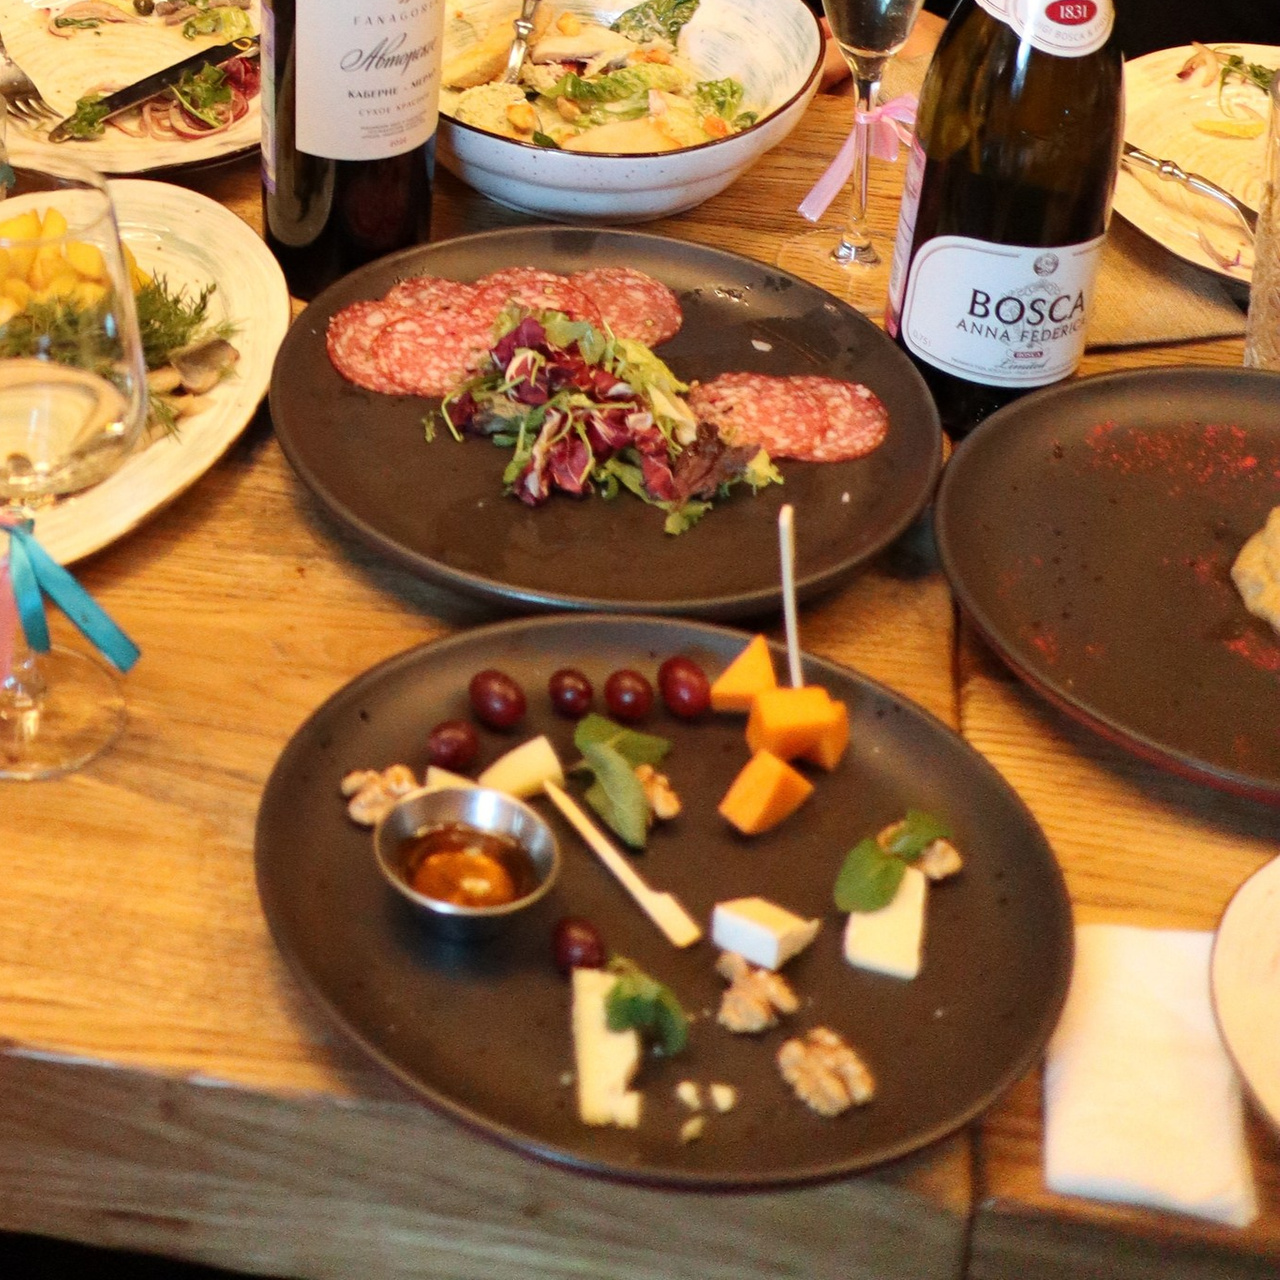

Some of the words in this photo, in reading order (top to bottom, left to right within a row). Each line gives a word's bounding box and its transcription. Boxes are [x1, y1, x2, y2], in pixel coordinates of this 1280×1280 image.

[1060, 4, 1088, 20] 1831
[348, 87, 398, 100] КАБЕРНЕ
[967, 287, 1086, 327] BOSCA
[956, 318, 1011, 342] ANNA
